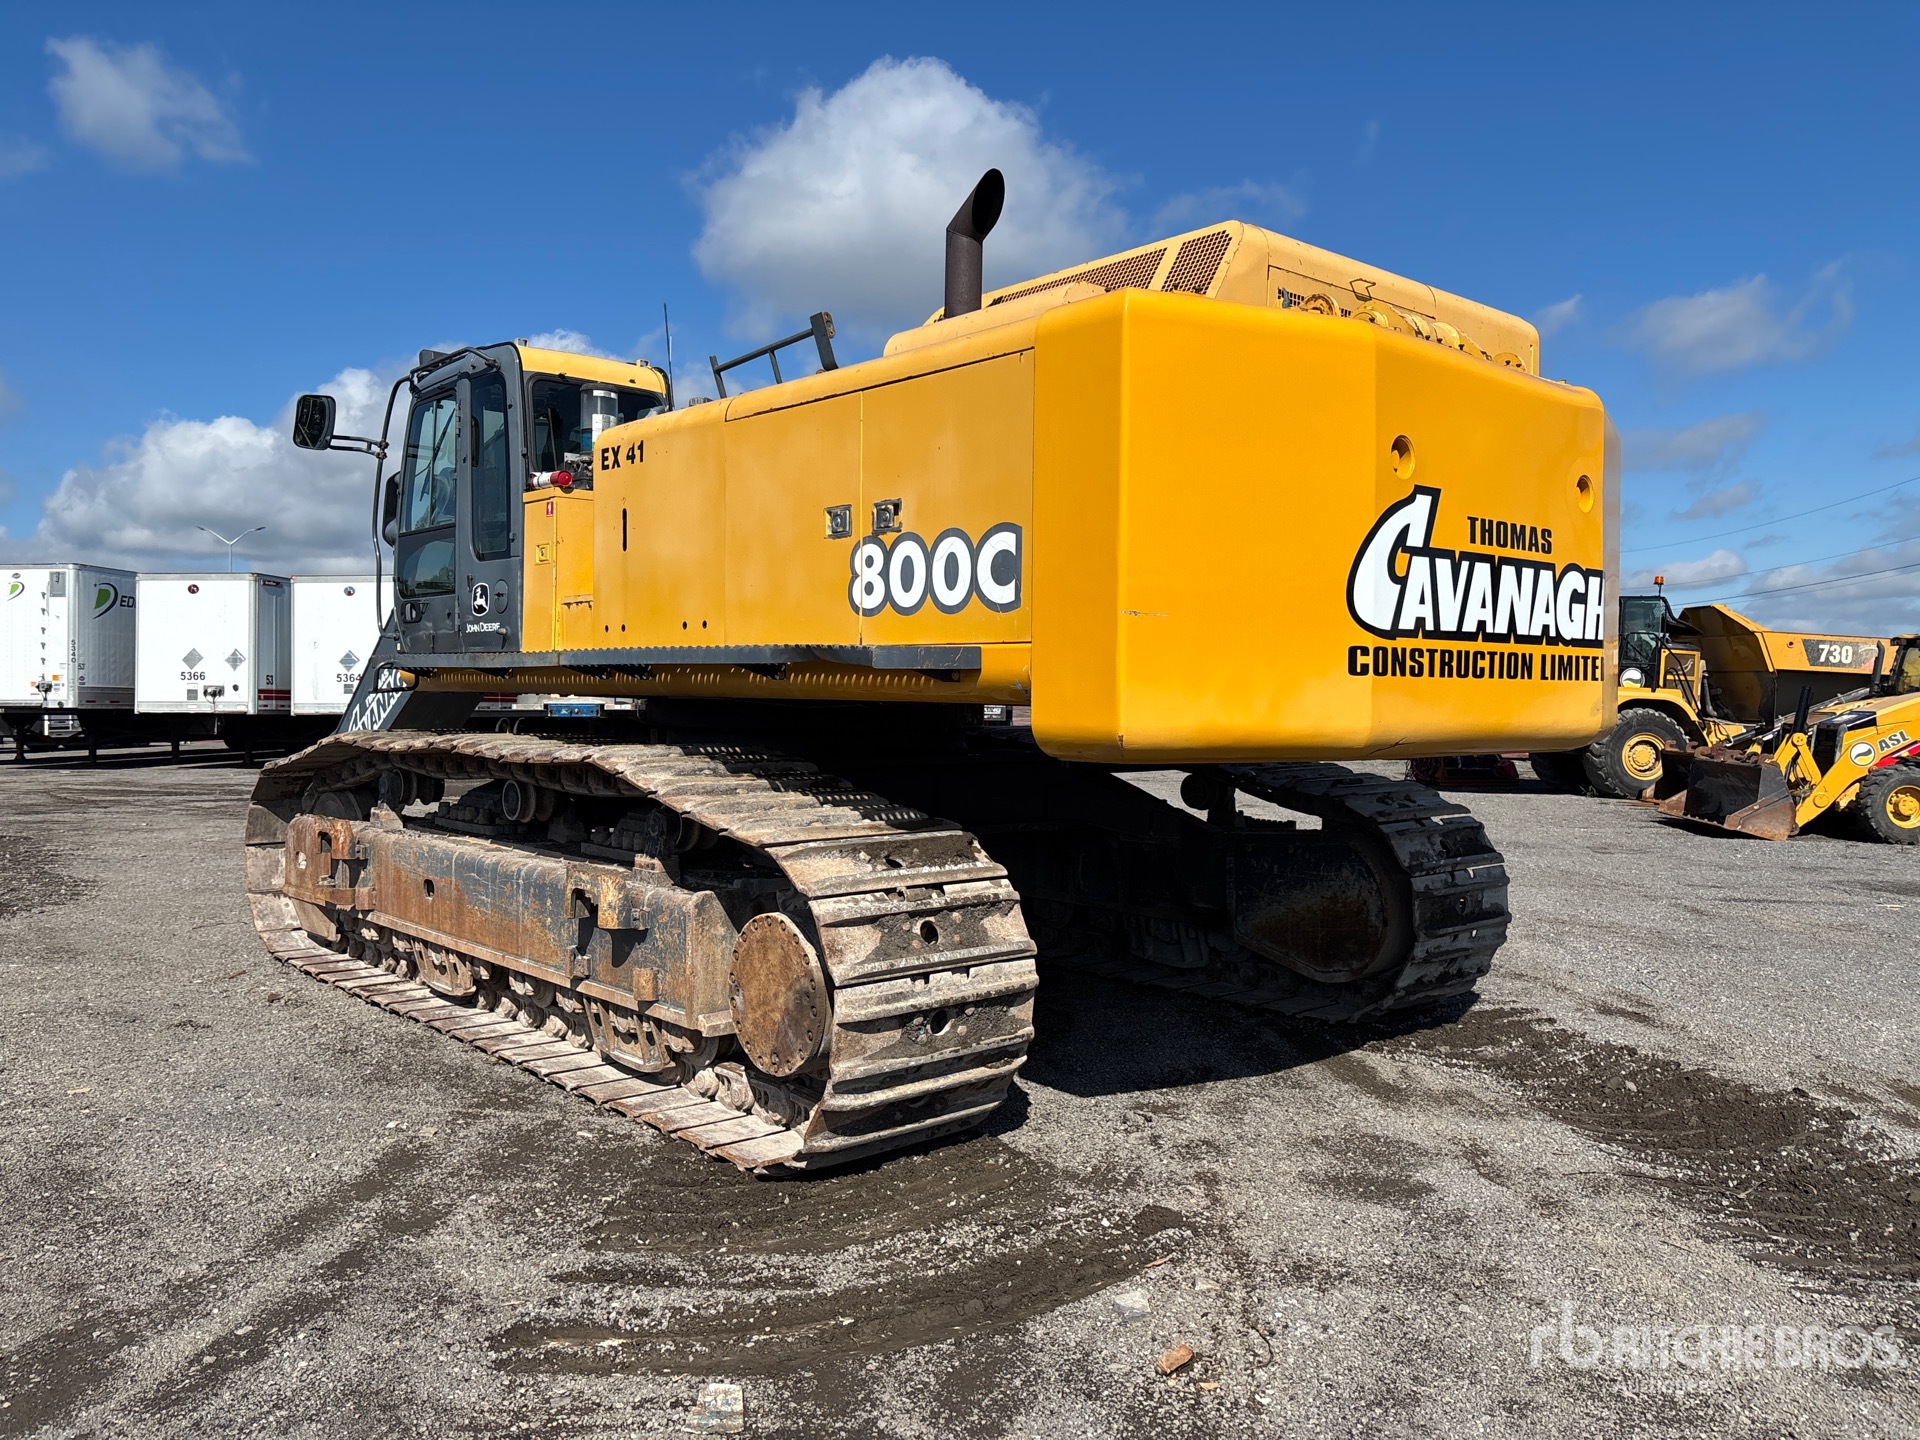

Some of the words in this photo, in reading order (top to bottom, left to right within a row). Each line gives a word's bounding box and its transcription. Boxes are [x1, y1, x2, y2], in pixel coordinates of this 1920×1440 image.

[601, 445, 621, 471] EX
[626, 440, 644, 465] 41
[1467, 516, 1553, 555] THOMAS
[848, 522, 1023, 617] 800C
[1347, 485, 1605, 648] CAVANAGH
[465, 623, 480, 633] JOHN
[1348, 645, 1534, 681] CONSTRUCTION
[1819, 645, 1853, 664] 730
[180, 671, 206, 681] 5366
[336, 673, 361, 683] 5364
[1878, 730, 1911, 752] ASL
